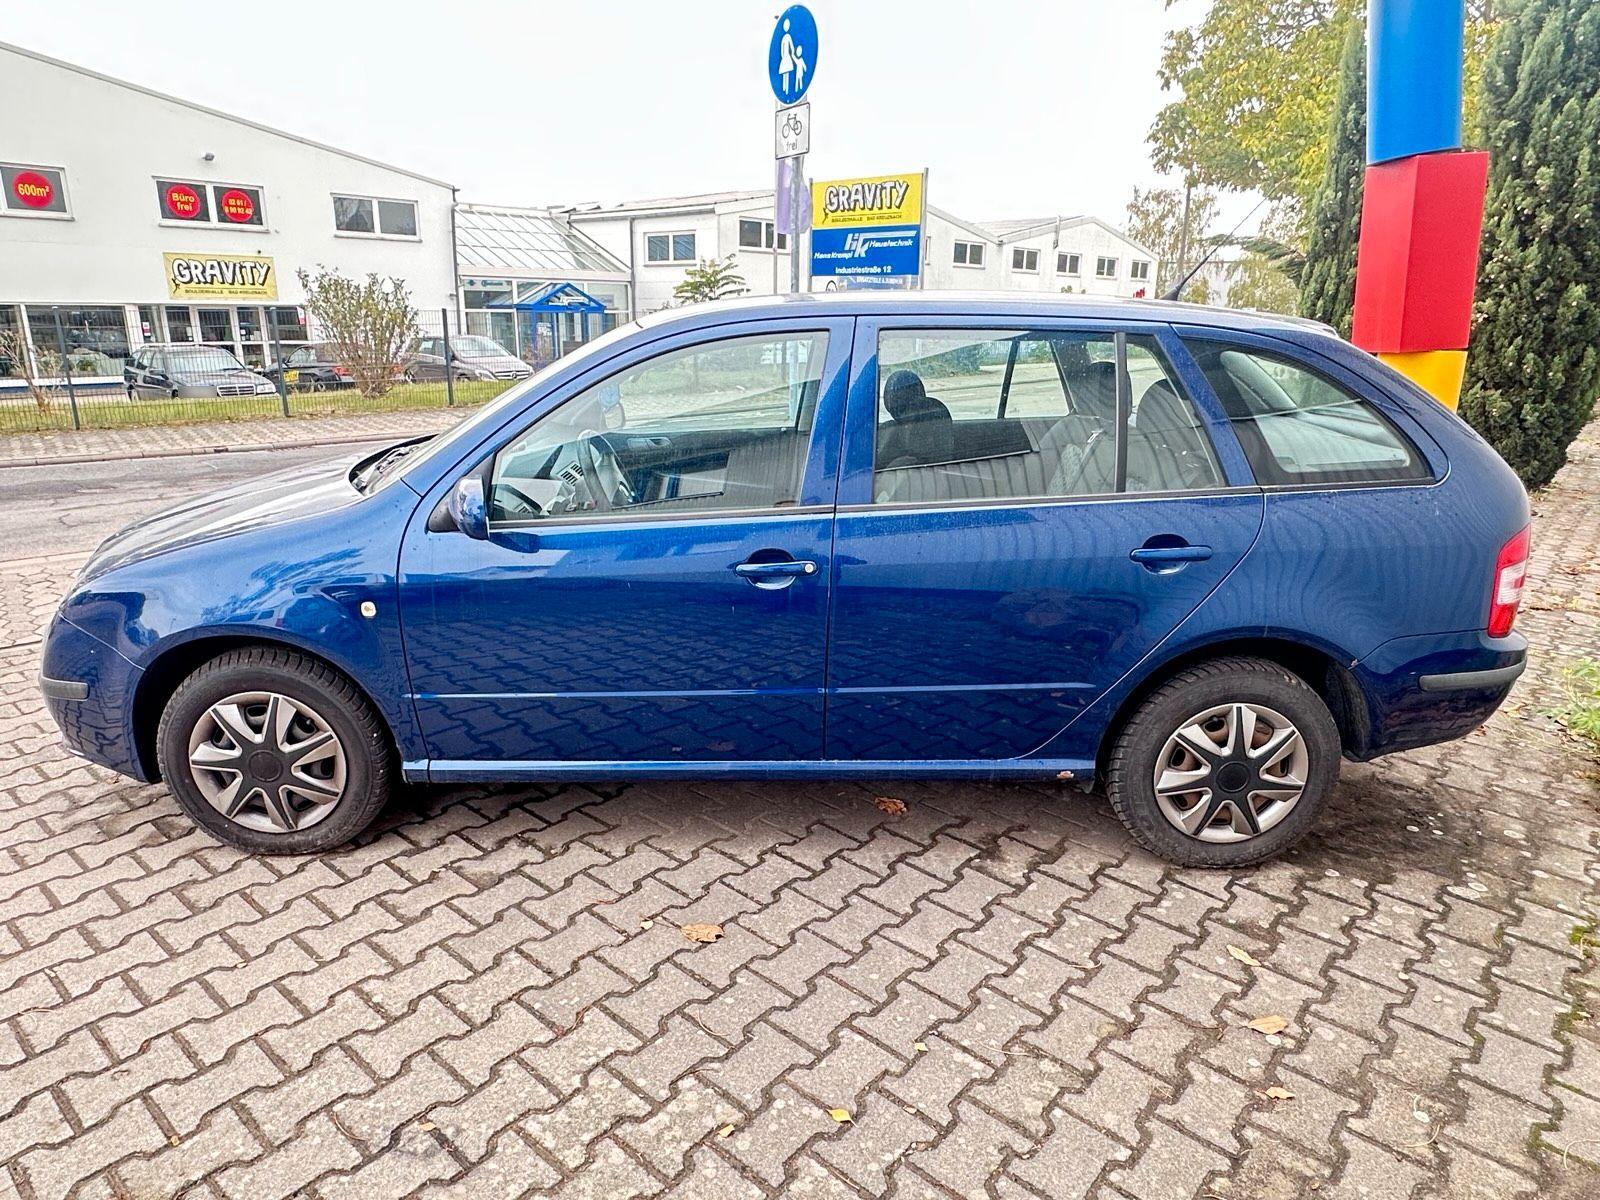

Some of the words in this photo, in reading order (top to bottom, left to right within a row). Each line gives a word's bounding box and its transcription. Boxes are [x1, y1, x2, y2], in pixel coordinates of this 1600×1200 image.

[786, 139, 798, 151] frei
[171, 192, 195, 202] Büro
[824, 180, 909, 213] GRAVITY
[176, 202, 193, 211] frei
[869, 239, 914, 248] Haustechnik
[172, 258, 271, 286] GRAVITY
[835, 266, 881, 274] Industriestraße
[883, 265, 892, 273] 12
